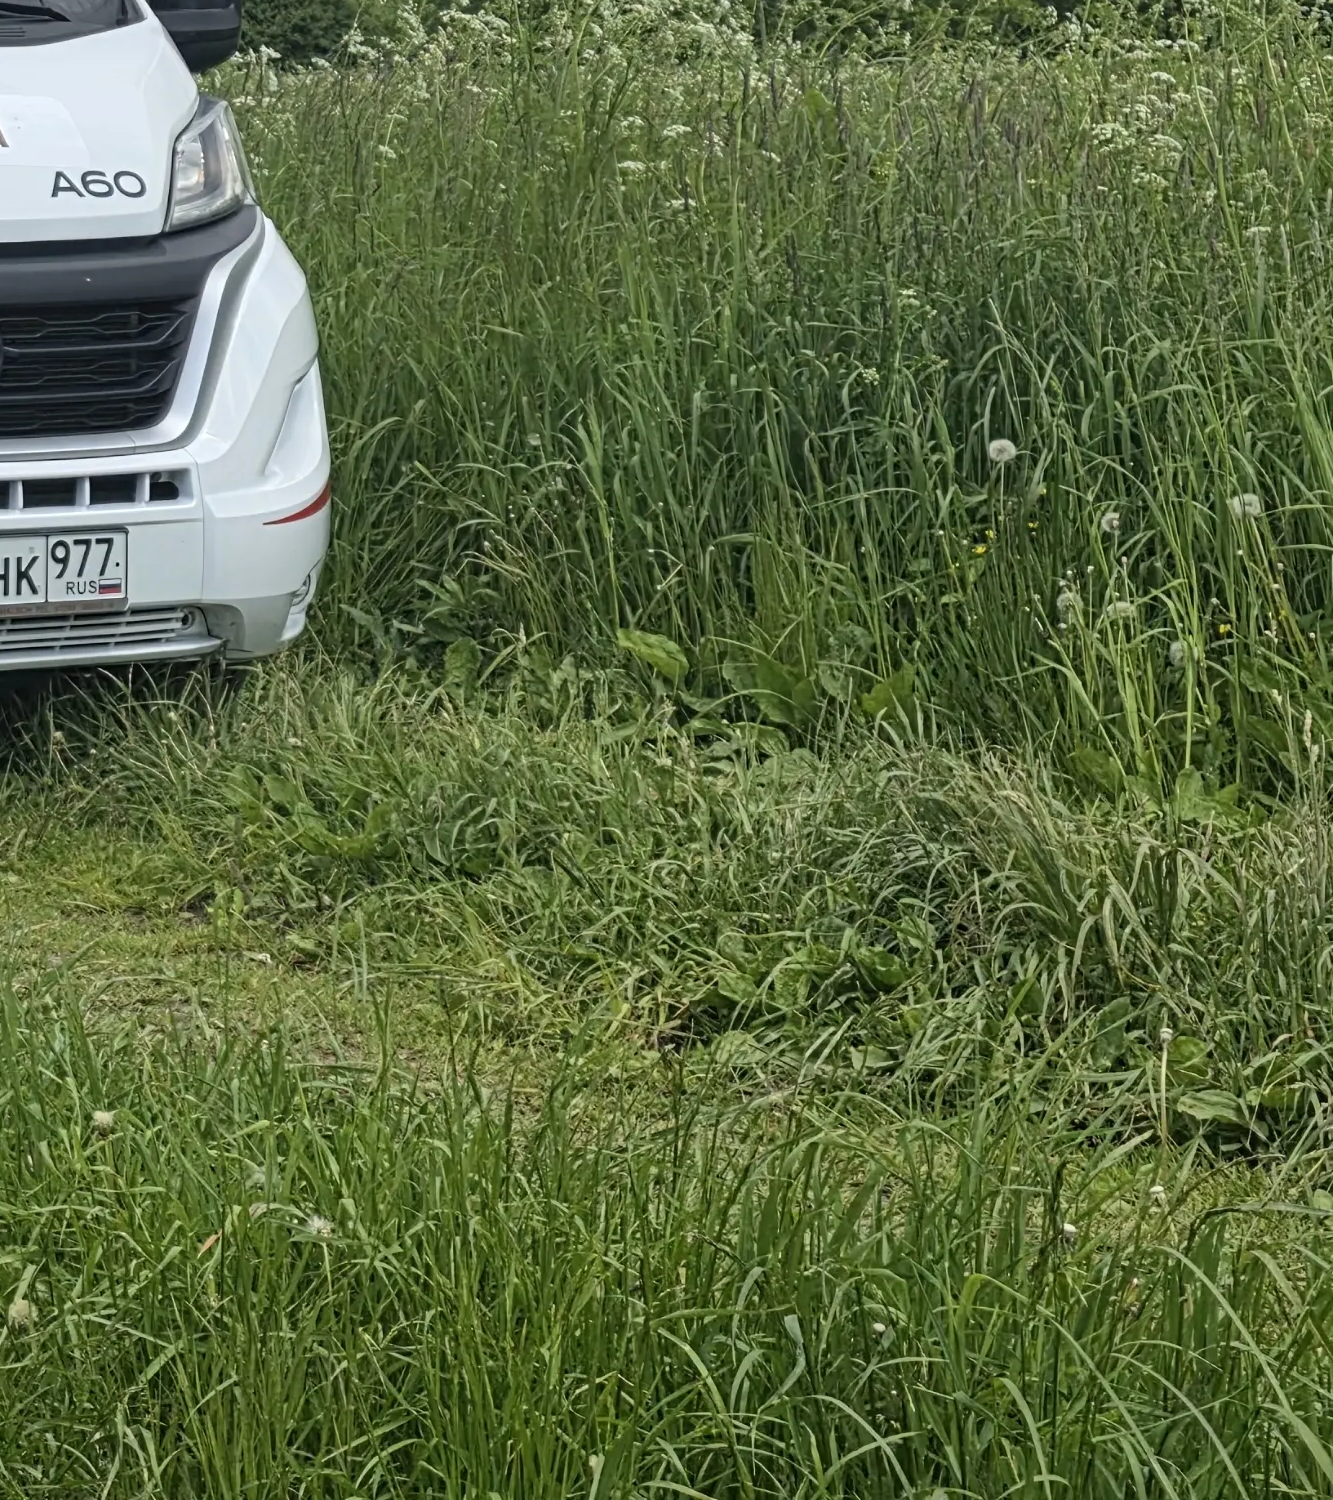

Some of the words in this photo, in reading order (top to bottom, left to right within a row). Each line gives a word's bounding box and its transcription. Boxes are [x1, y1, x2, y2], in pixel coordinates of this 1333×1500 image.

[51, 170, 147, 198] A60
[50, 537, 114, 580] 977
[65, 580, 97, 595] RUS
